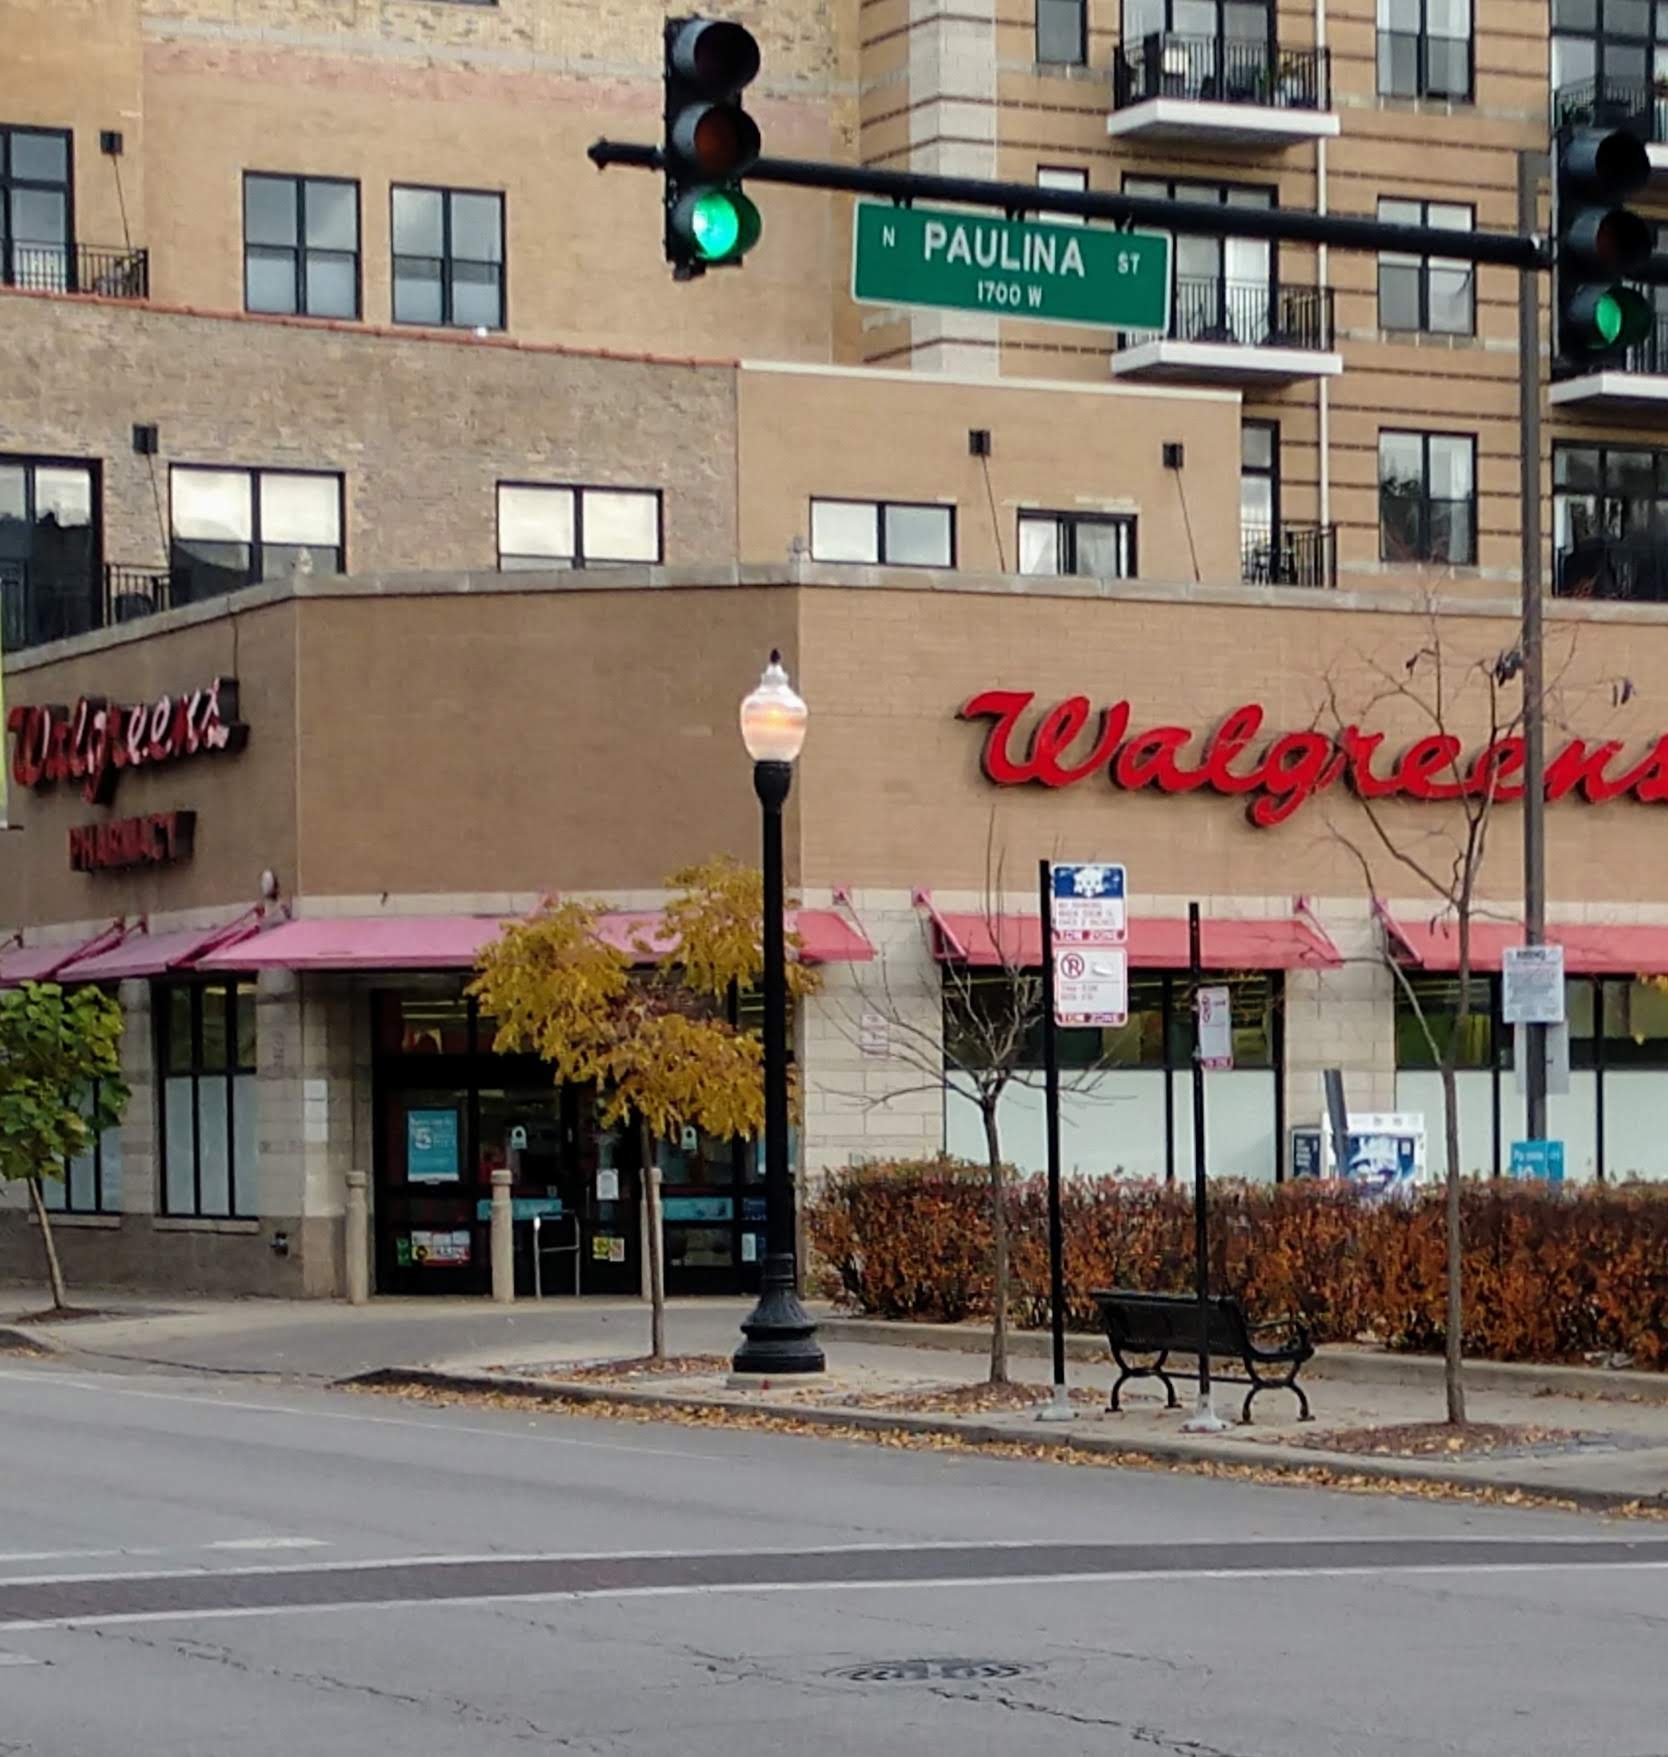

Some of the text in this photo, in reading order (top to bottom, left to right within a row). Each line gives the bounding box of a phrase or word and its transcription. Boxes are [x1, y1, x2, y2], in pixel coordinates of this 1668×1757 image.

[882, 221, 1140, 277] N PAULINA ST
[977, 280, 1042, 307] 1700 W
